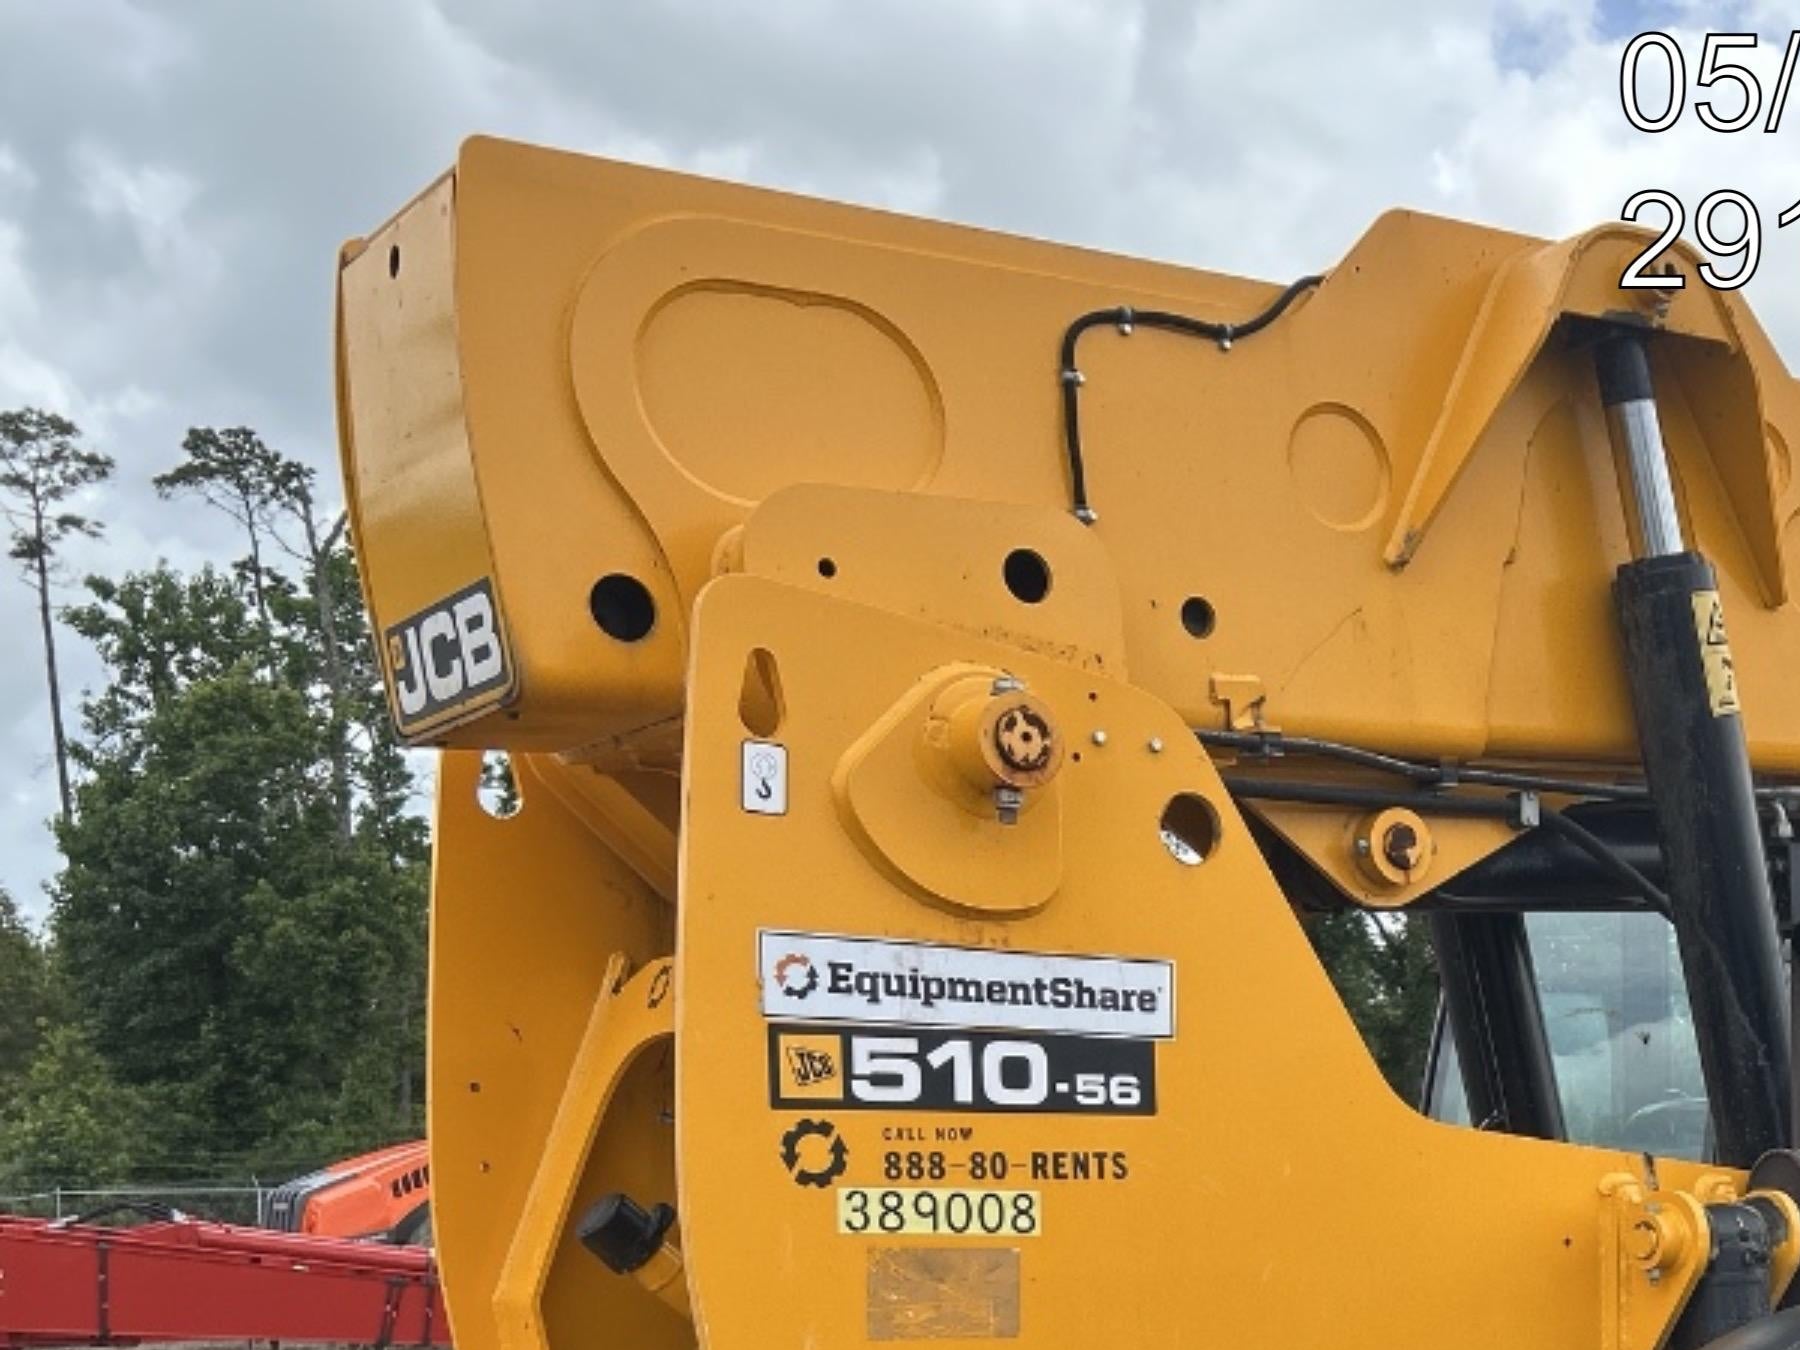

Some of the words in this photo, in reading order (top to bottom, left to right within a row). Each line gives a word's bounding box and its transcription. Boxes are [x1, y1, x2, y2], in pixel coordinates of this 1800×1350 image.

[397, 591, 502, 715] JCB
[827, 961, 1162, 1013] EquipmentShare
[851, 1036, 1142, 1107] 510-56
[882, 1126, 926, 1142] CALL
[935, 1126, 974, 1142] NOW
[883, 1150, 1129, 1181] 888-80-RENTS
[844, 1190, 1037, 1234] 389008
